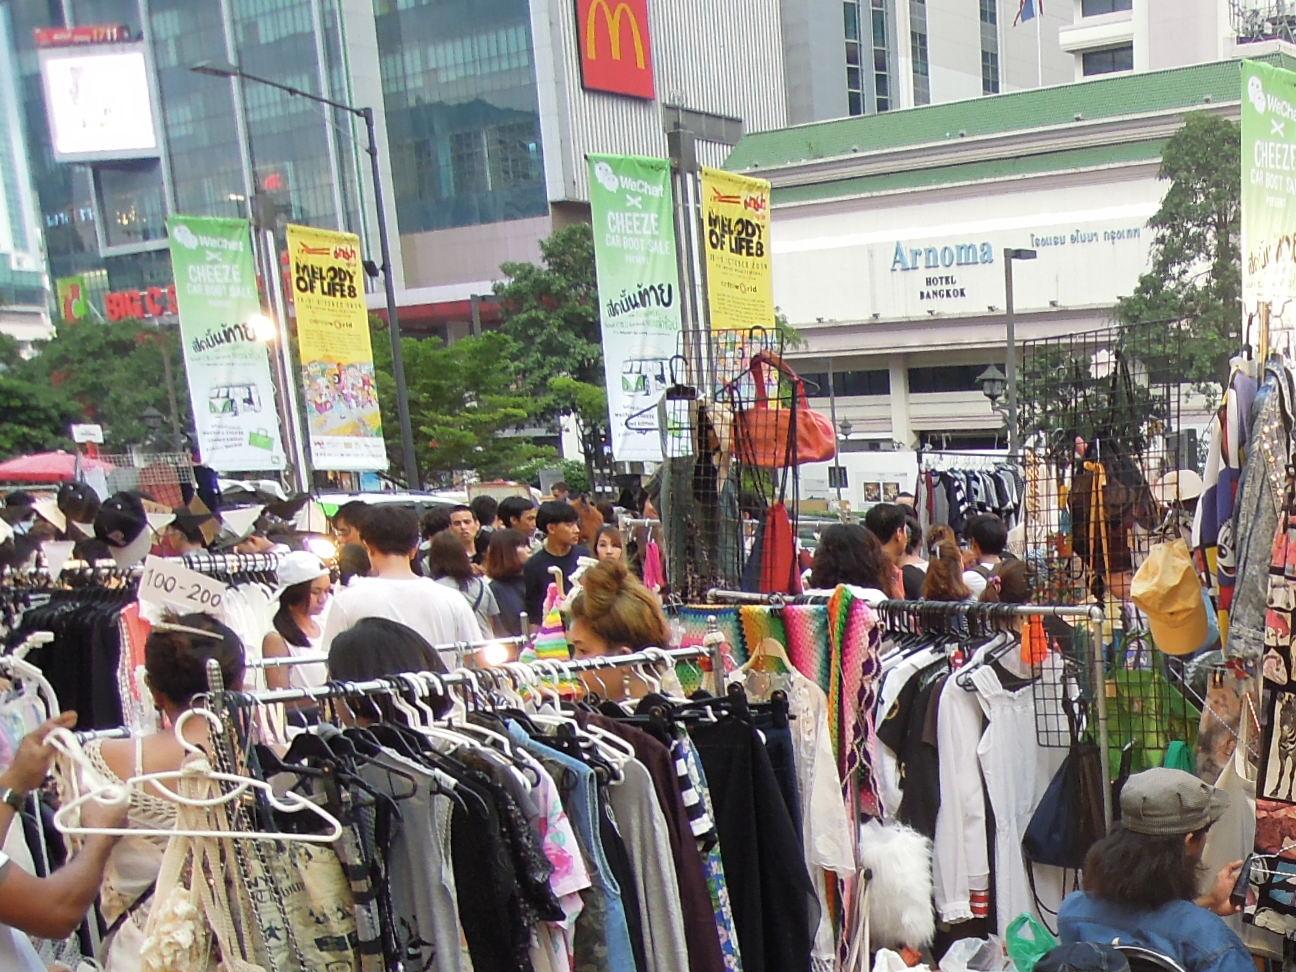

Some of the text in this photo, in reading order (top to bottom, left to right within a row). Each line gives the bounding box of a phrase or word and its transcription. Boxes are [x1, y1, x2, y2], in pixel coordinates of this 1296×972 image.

[1254, 140, 1296, 171] CHEEZE
[619, 176, 664, 198] WeChat
[607, 211, 659, 235] CHEEZE
[708, 209, 765, 239] MELODY
[199, 235, 244, 252] WeChat
[606, 233, 622, 248] CAR
[623, 236, 645, 252] BOOT
[708, 228, 725, 251] OF
[890, 240, 994, 272] Arnoma
[188, 264, 241, 284] CHEEZE
[295, 261, 355, 284] MELODY
[925, 275, 957, 286] HOTEL
[296, 276, 317, 294] OF
[919, 287, 966, 301] BANGKOK
[105, 288, 144, 321] BIG
